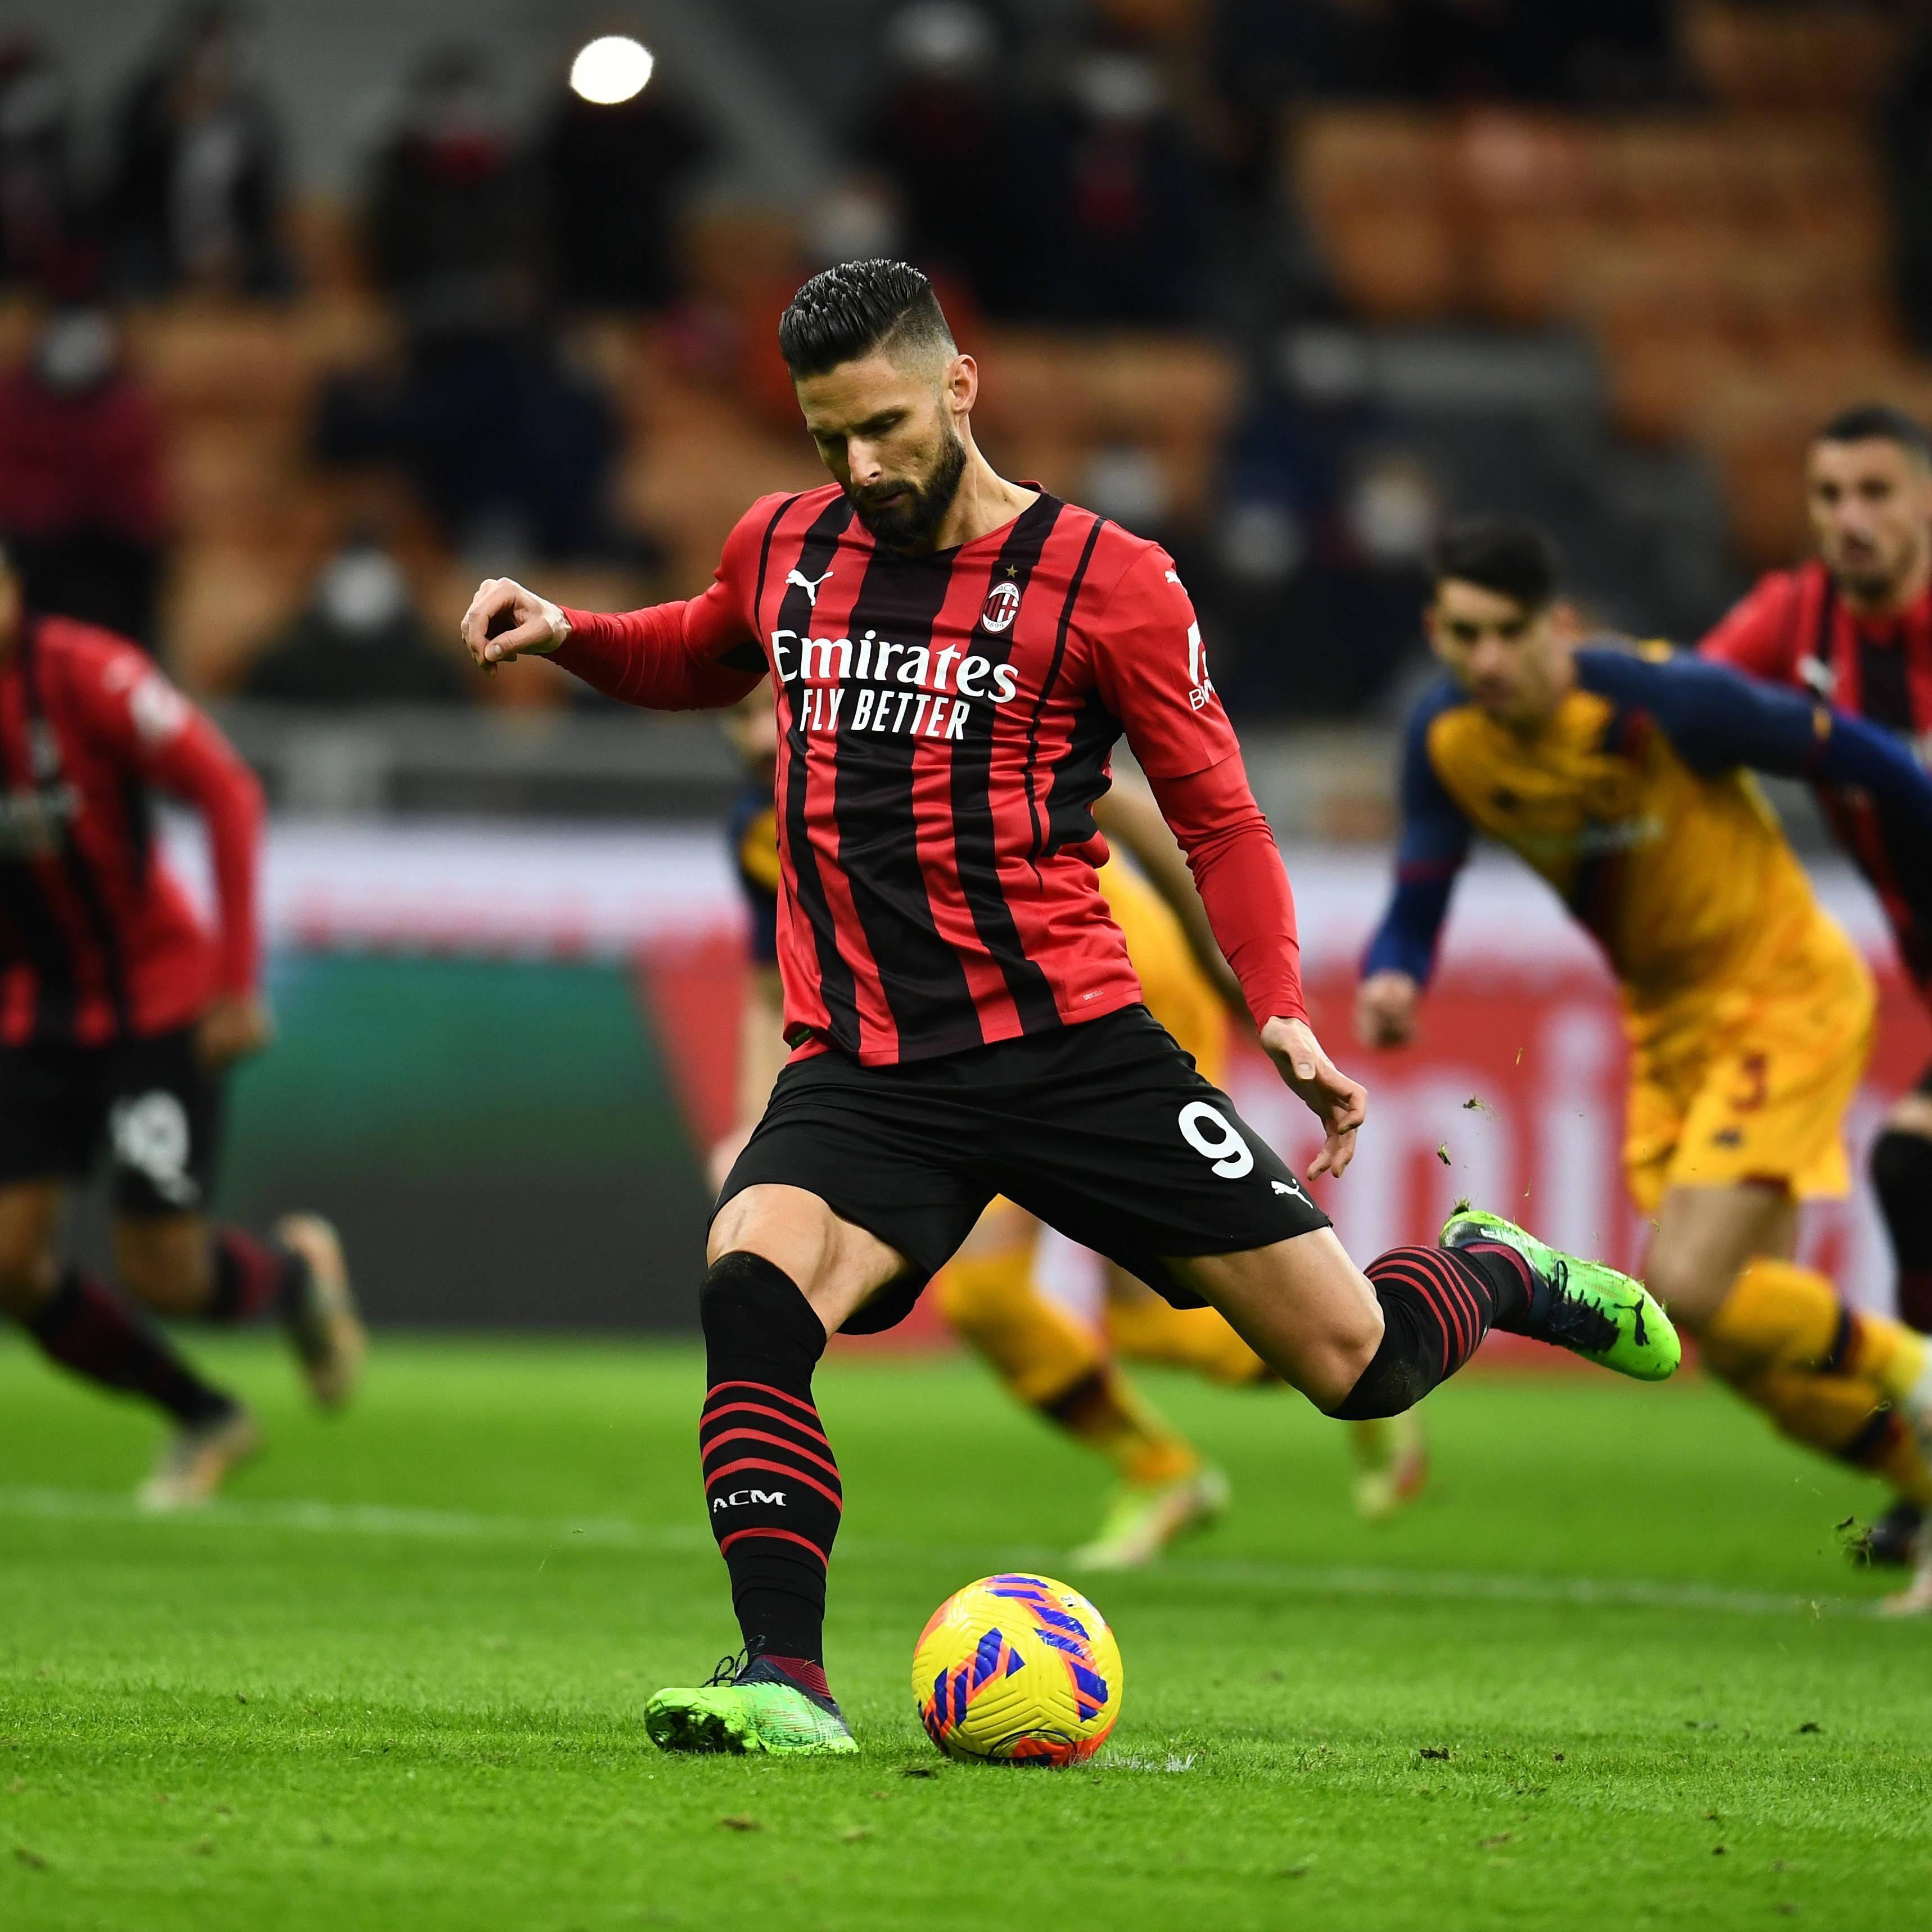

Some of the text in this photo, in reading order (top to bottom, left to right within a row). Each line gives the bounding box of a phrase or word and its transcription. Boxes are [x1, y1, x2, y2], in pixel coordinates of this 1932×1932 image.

[995, 584, 1016, 595] ACM
[771, 629, 1019, 703] Emirates
[799, 688, 970, 740] FLY BETTER
[1178, 1100, 1254, 1179] 9
[712, 1489, 787, 1514] ACM
